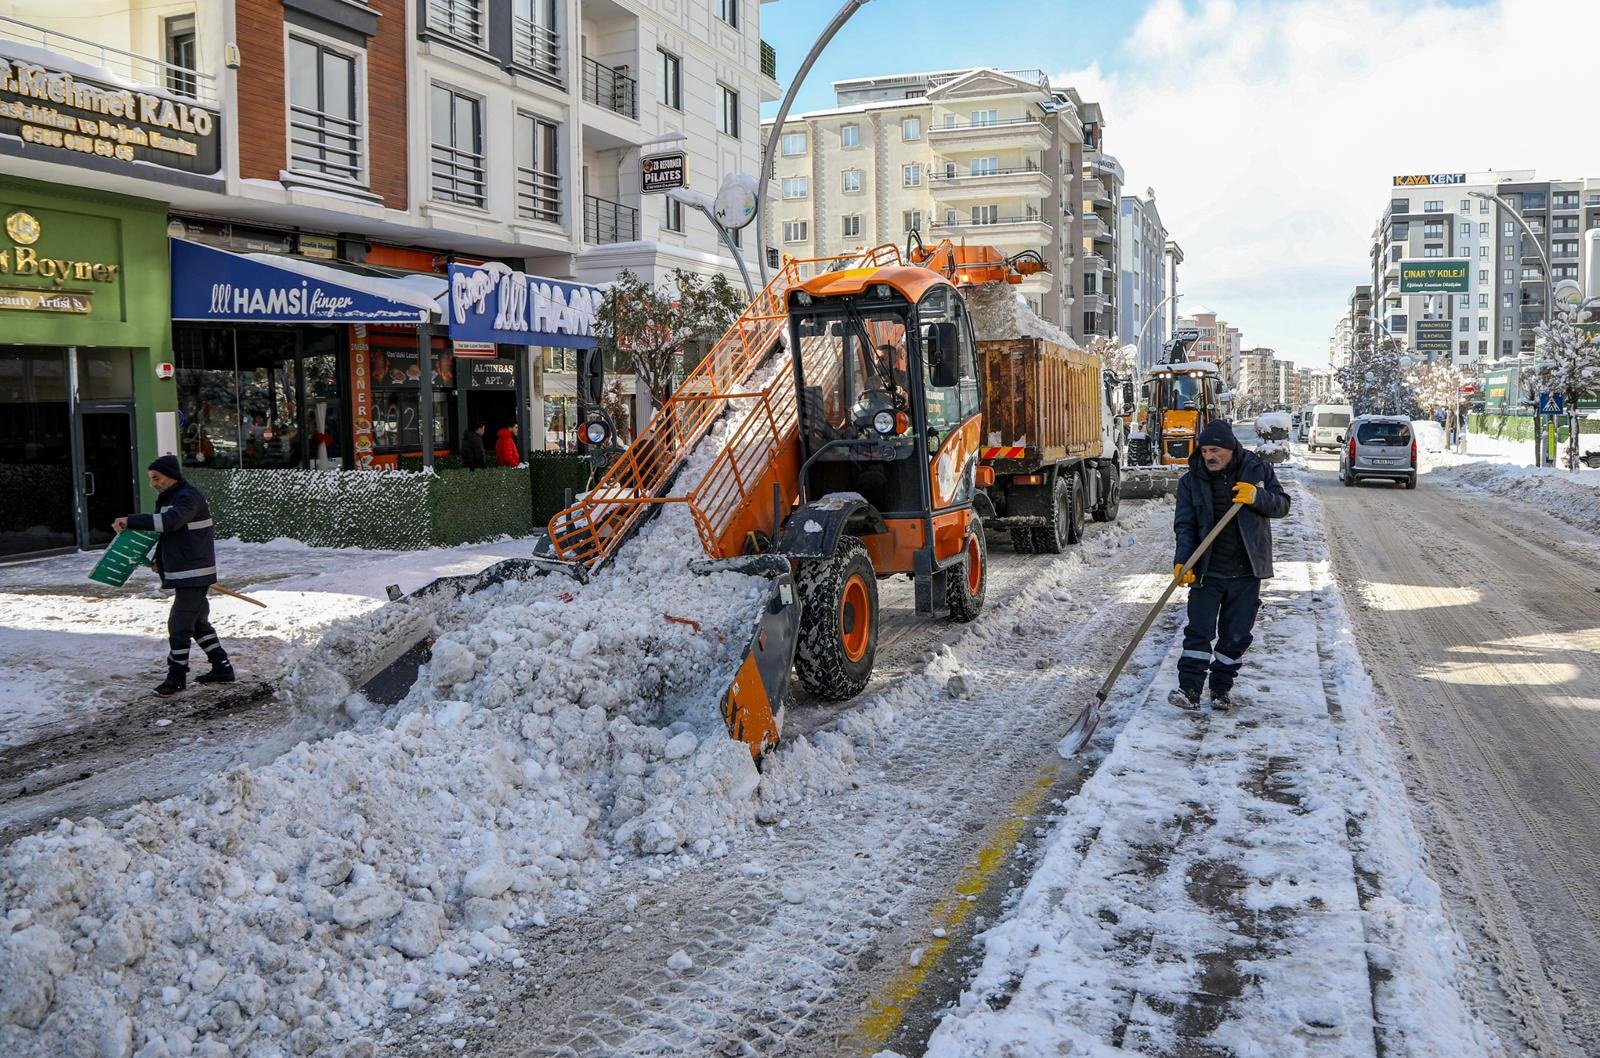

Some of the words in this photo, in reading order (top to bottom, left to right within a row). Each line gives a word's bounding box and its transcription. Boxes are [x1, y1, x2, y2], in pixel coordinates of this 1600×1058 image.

[14, 246, 120, 285] Boyner
[37, 295, 71, 308] Artist
[310, 288, 353, 317] finger
[473, 364, 514, 375] ALTINBAŞ
[484, 376, 504, 385] APT.
